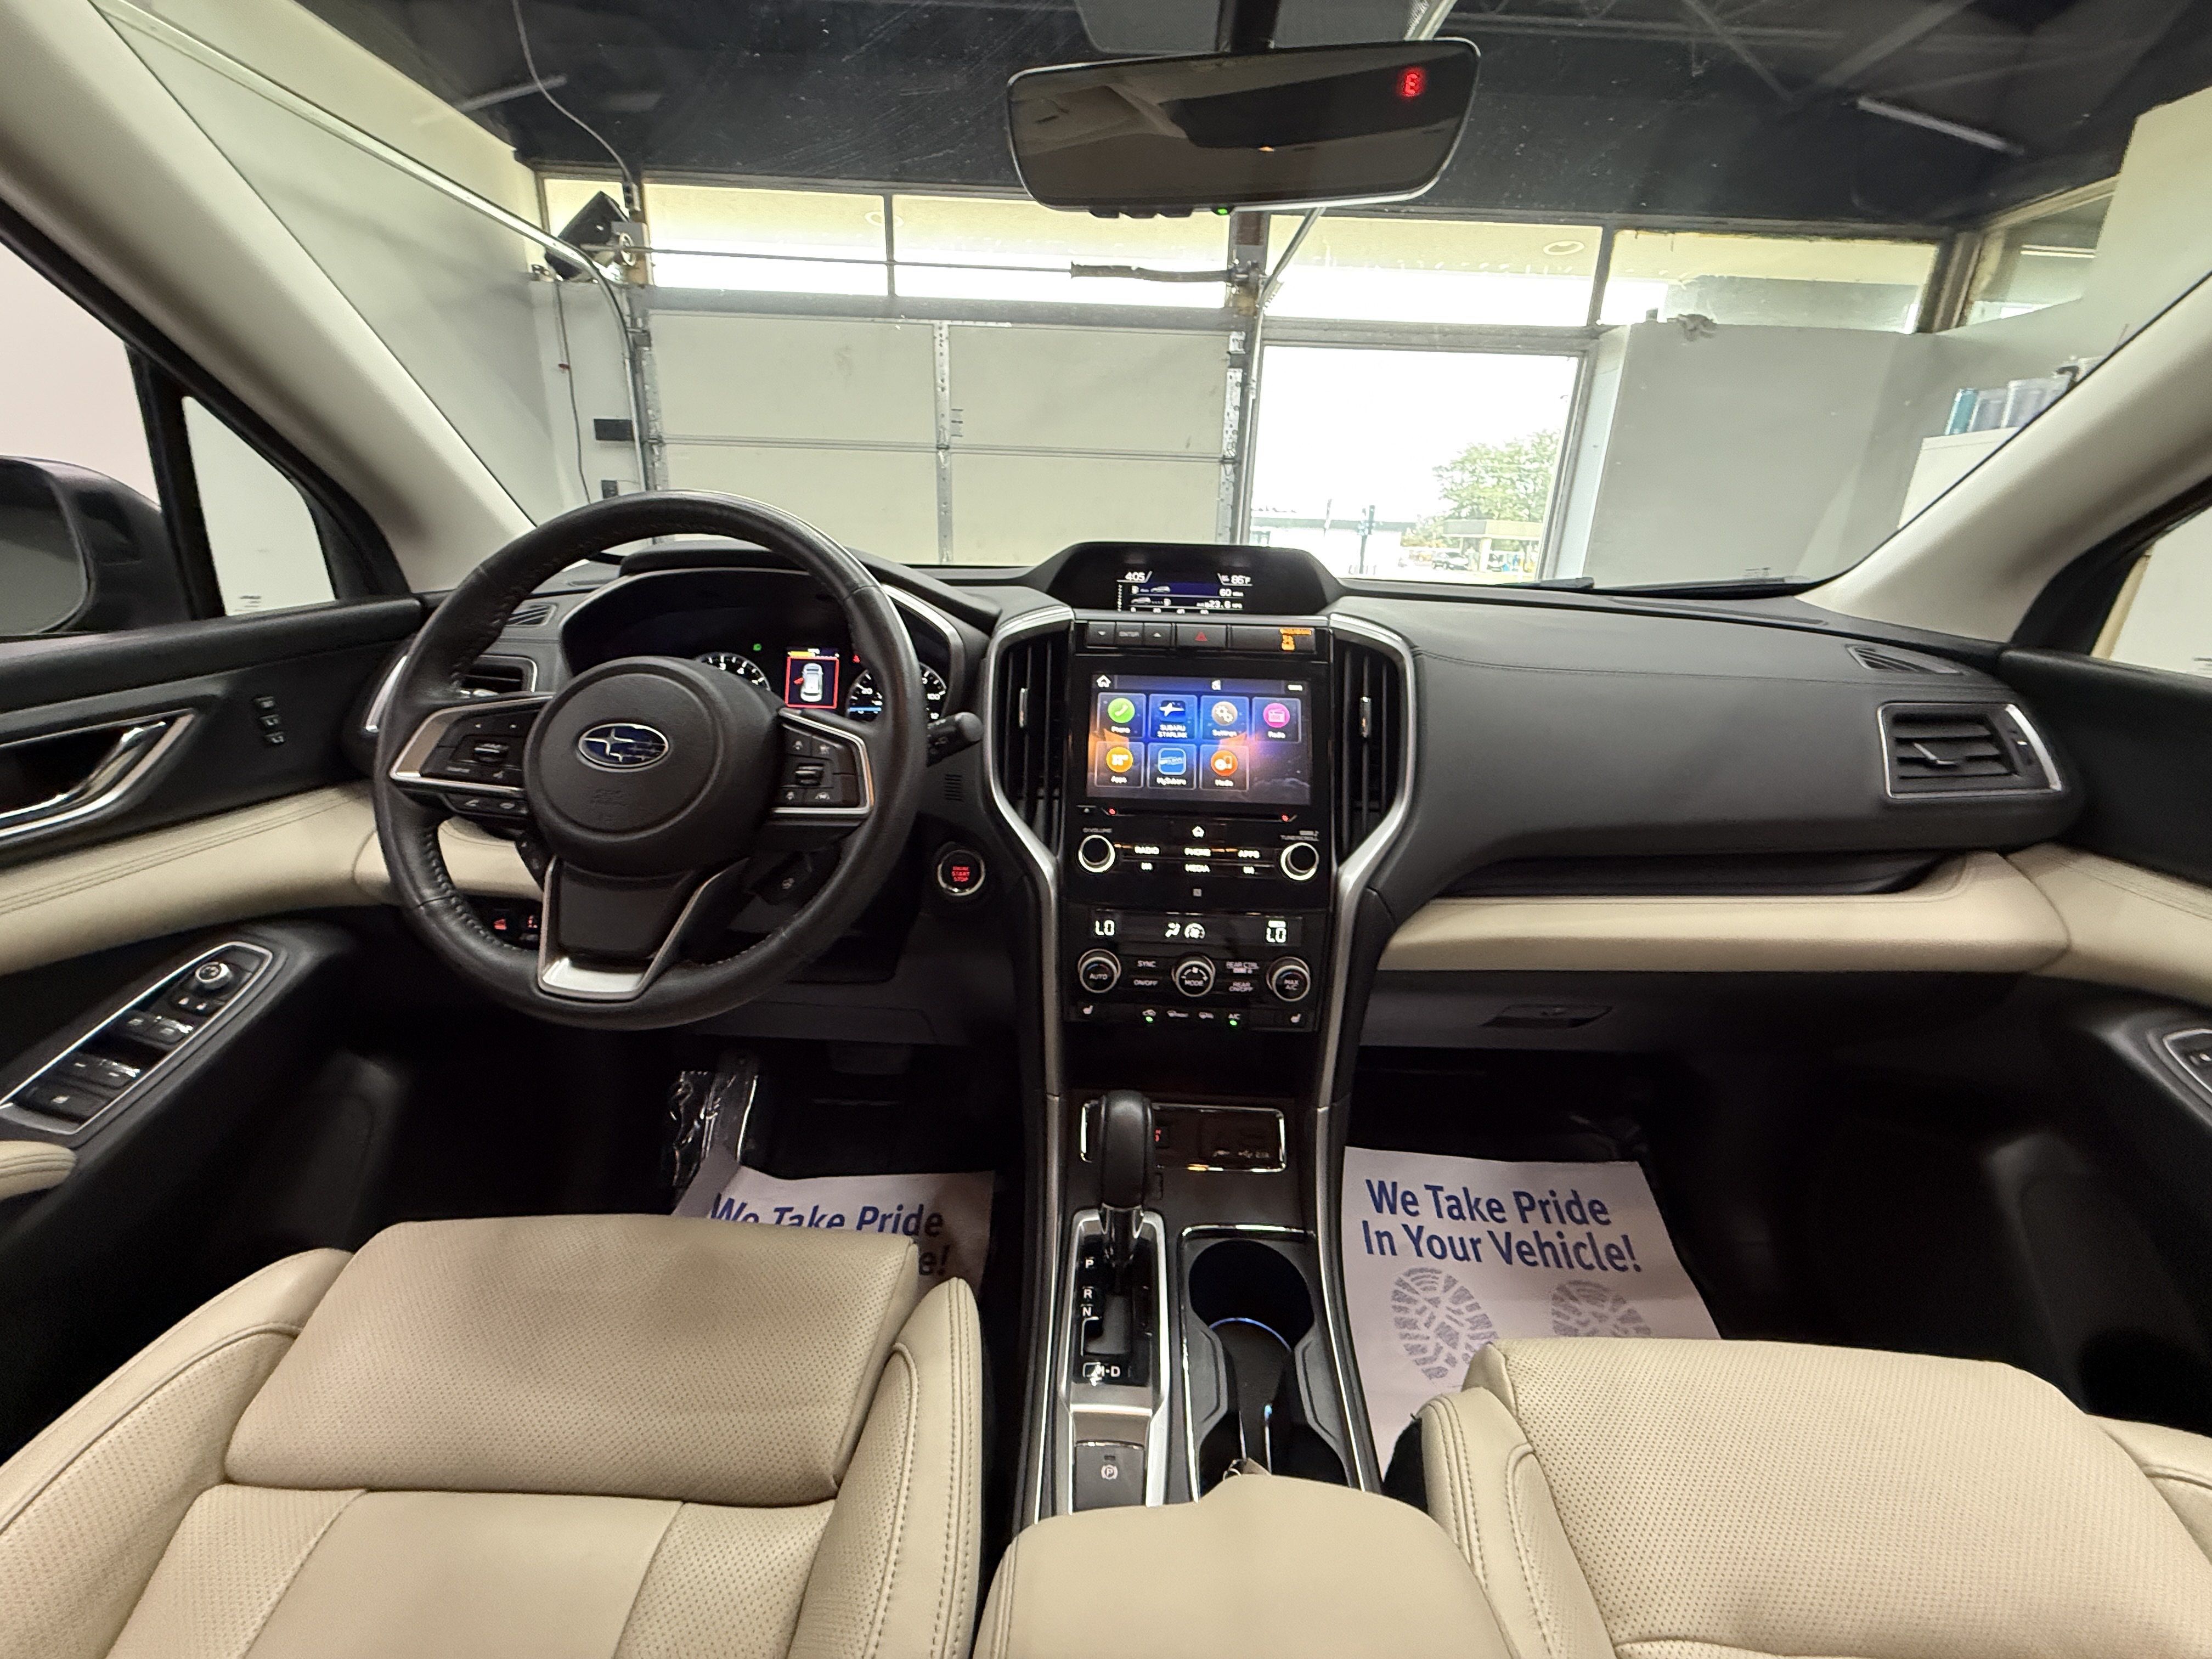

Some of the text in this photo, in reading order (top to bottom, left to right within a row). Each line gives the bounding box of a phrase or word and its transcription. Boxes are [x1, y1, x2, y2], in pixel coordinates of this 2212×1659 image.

[1095, 920, 1115, 936] LO
[1266, 927, 1286, 943] LO
[1365, 1178, 1611, 1226] We Take Pride
[856, 1204, 944, 1237] Pride
[1362, 1220, 1642, 1273] In Your Vehicle!
[1085, 1259, 1094, 1269] P
[1084, 1289, 1093, 1300] R
[1082, 1307, 1092, 1317] N
